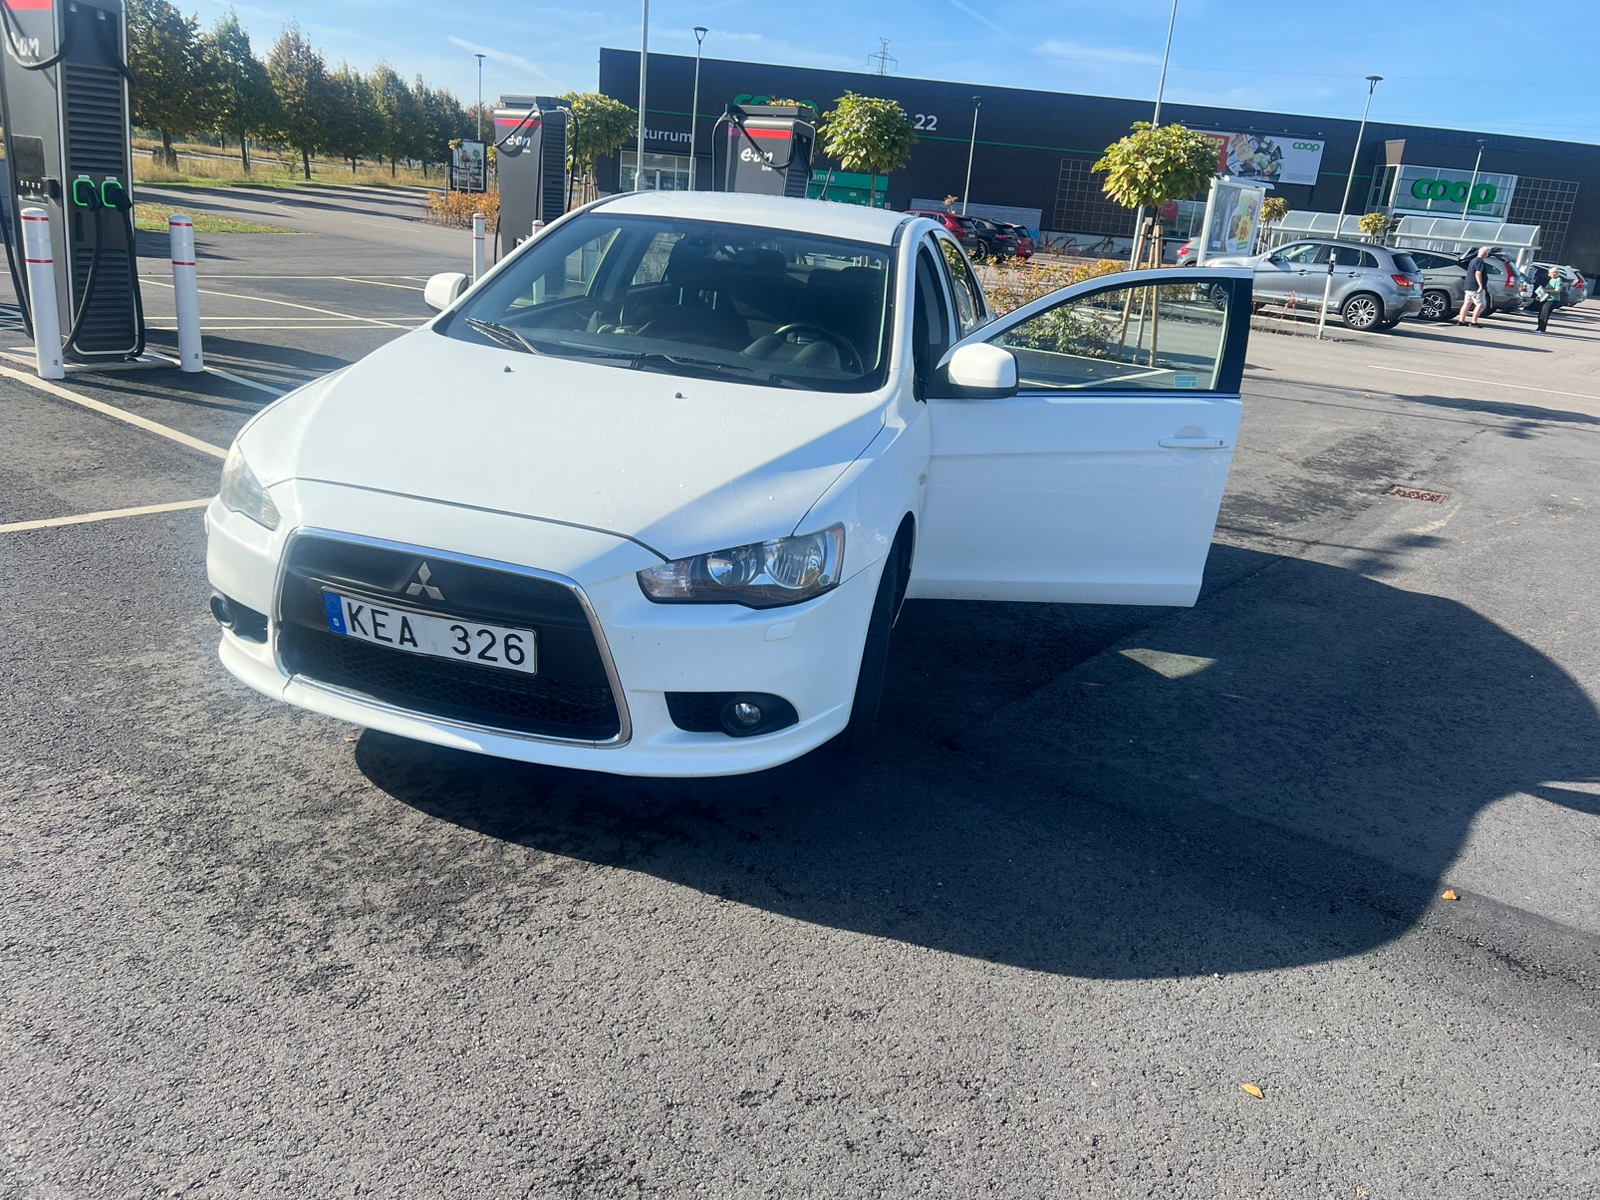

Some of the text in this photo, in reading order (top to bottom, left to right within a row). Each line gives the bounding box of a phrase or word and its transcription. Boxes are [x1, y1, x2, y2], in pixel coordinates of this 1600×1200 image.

[913, 113, 938, 131] 22
[1293, 141, 1320, 153] coop
[1411, 178, 1497, 210] coop
[332, 617, 340, 628] S
[347, 601, 525, 666] KEA 326
